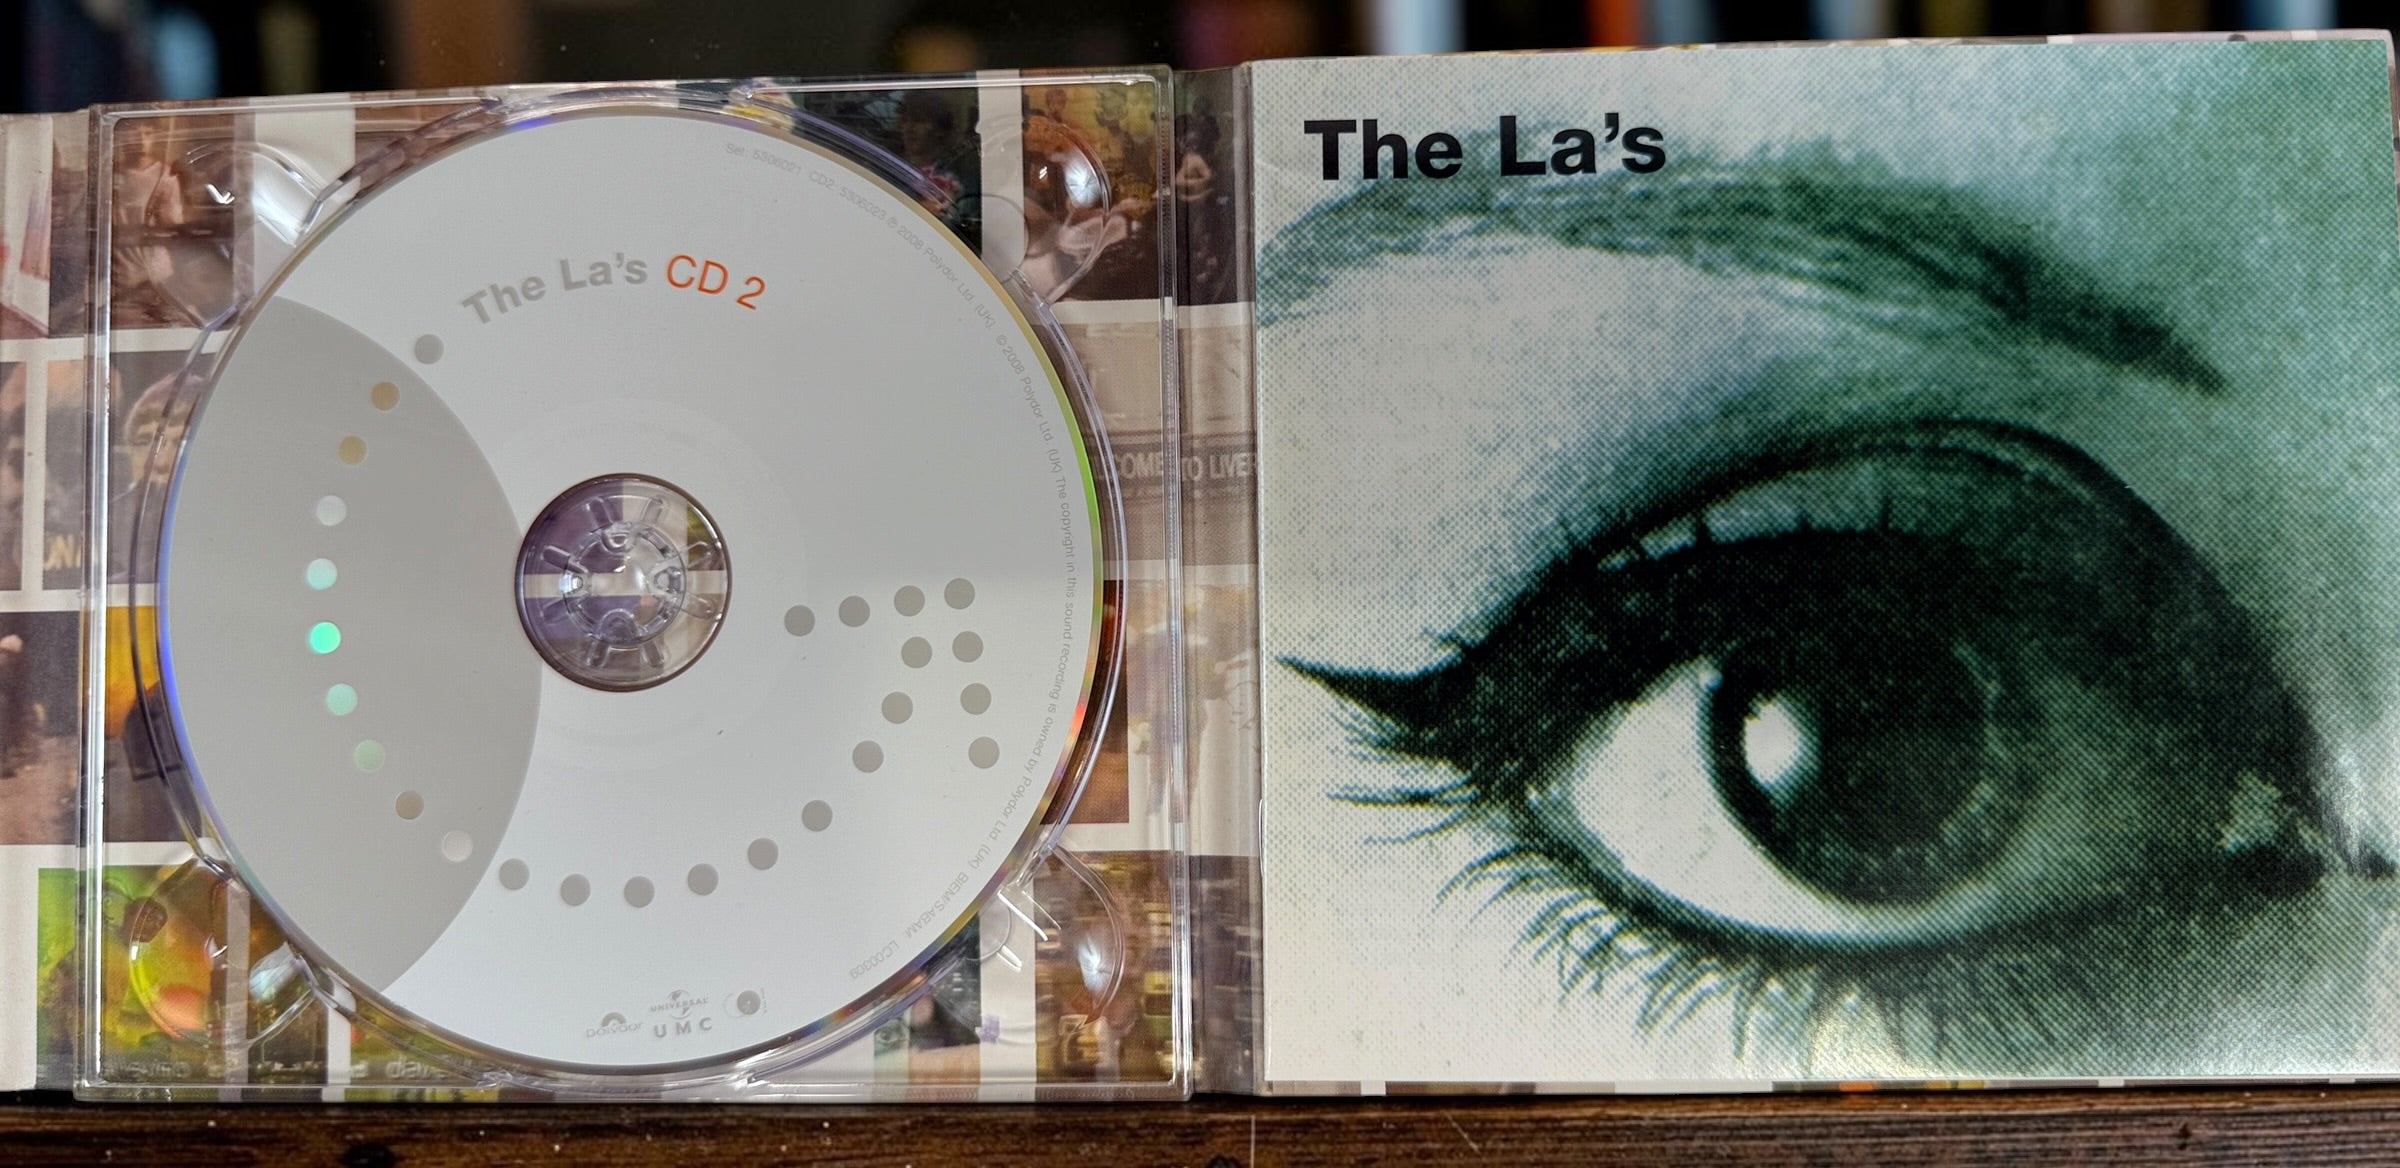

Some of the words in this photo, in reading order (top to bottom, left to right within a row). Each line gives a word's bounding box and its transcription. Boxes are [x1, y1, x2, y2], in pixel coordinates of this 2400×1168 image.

[1304, 119, 1463, 181] The
[1499, 112, 1667, 177] La’s
[463, 275, 546, 325] The
[559, 252, 648, 291] La’s
[666, 254, 728, 296] CD
[736, 276, 767, 310] 2
[1018, 377, 1046, 418] Polydor
[1054, 475, 1069, 499] The
[1181, 455, 1204, 482] TO
[1057, 501, 1076, 558] copyright
[1049, 644, 1069, 698] recording
[1033, 717, 1052, 755] owned
[1023, 758, 1037, 773] by
[1001, 776, 1031, 819] Polydor
[650, 996, 709, 1012] UNIVERSAL
